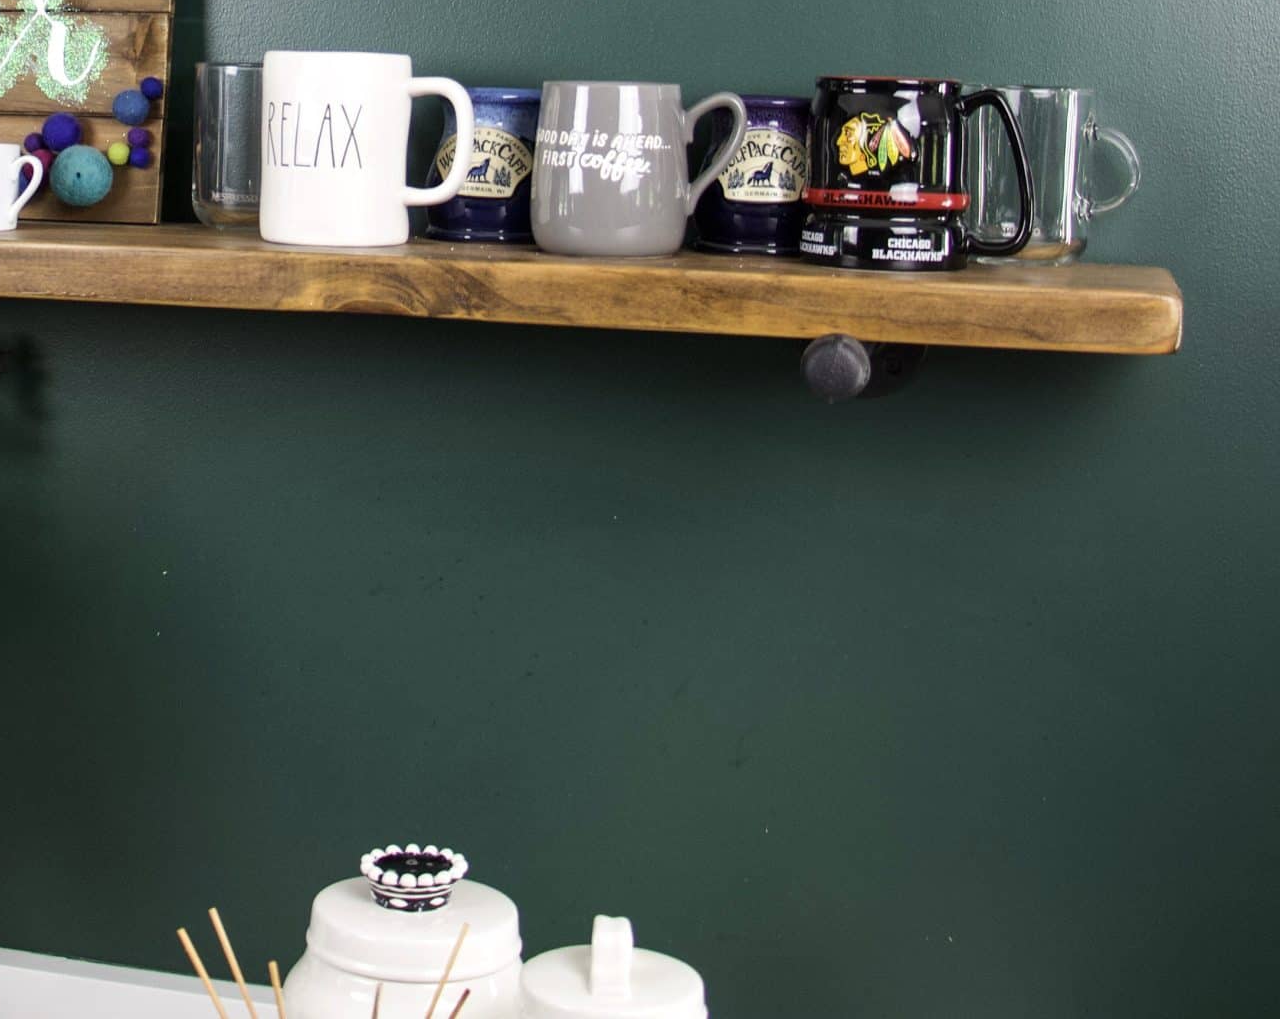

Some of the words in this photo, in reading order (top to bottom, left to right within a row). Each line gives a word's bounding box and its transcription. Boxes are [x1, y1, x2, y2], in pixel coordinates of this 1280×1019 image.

[266, 101, 362, 169] RELAX
[541, 149, 576, 169] FIRST
[887, 238, 931, 250] CHICAGO
[872, 248, 943, 262] BLACKHAWKS
